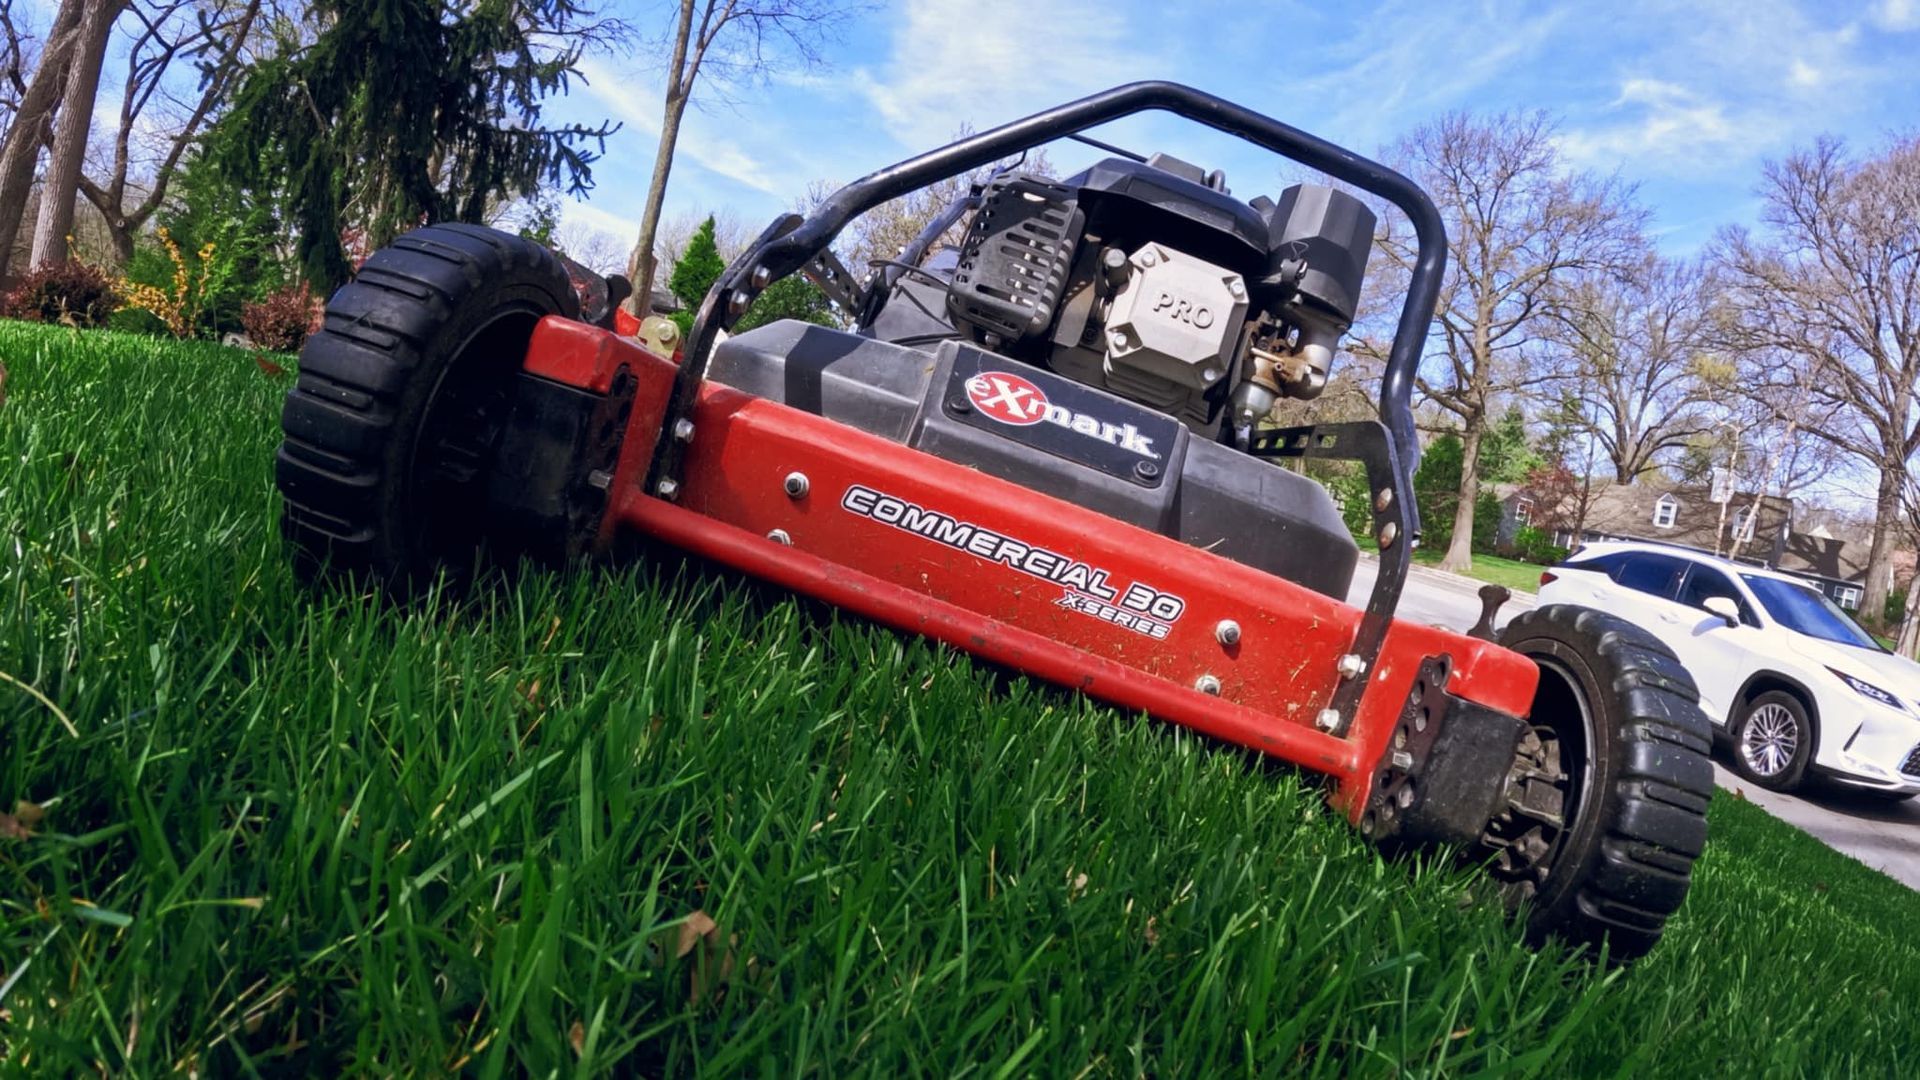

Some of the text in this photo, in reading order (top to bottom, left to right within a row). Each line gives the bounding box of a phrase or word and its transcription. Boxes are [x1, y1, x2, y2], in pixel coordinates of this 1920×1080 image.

[1153, 291, 1214, 329] PRO
[842, 486, 1185, 623] COMMERCIAL 30
[1056, 590, 1171, 638] X-SERIES
